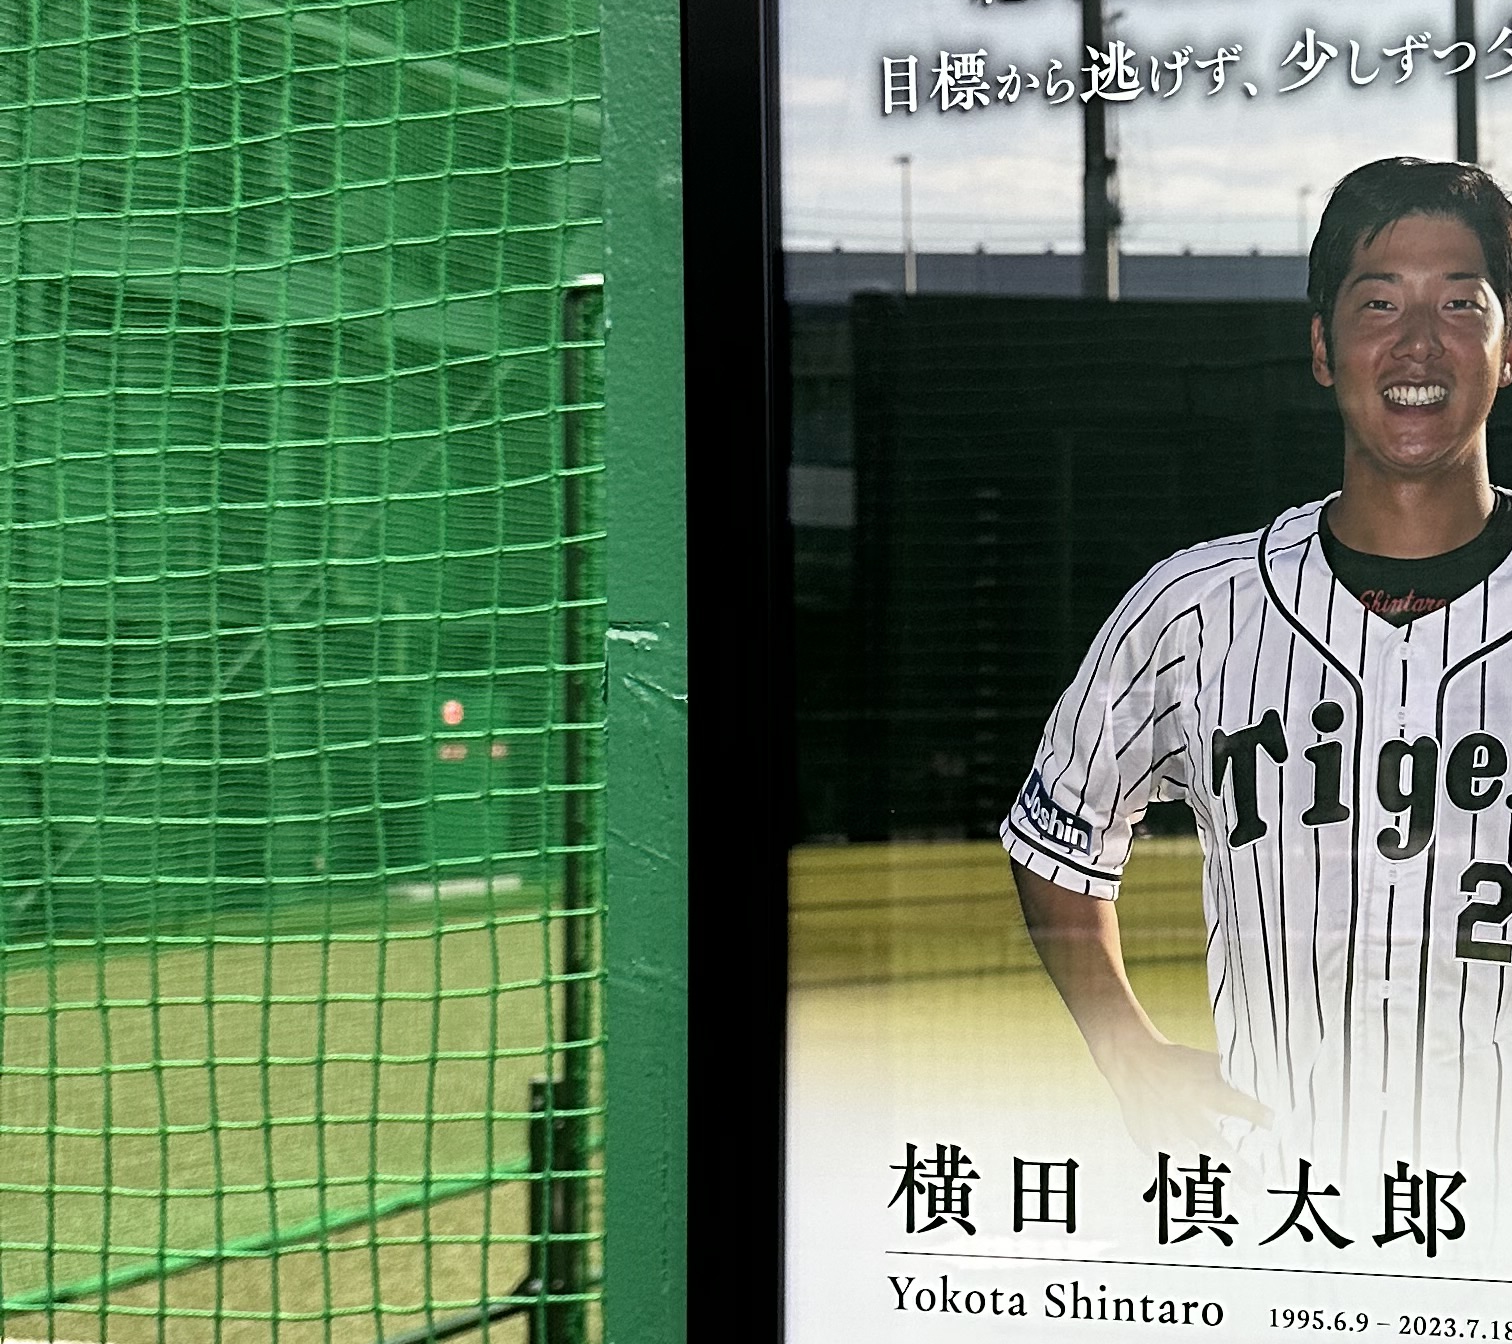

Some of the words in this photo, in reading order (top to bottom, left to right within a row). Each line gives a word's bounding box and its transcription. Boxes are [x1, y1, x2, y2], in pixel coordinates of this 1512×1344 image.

[1023, 781, 1089, 850] Joshin
[886, 1141, 1080, 1237] 横田
[1142, 1150, 1468, 1259] 慎太郎
[886, 1274, 1029, 1318] Yokota
[1044, 1280, 1225, 1328] Shintaro
[1269, 1308, 1370, 1334] 1995.6.9
